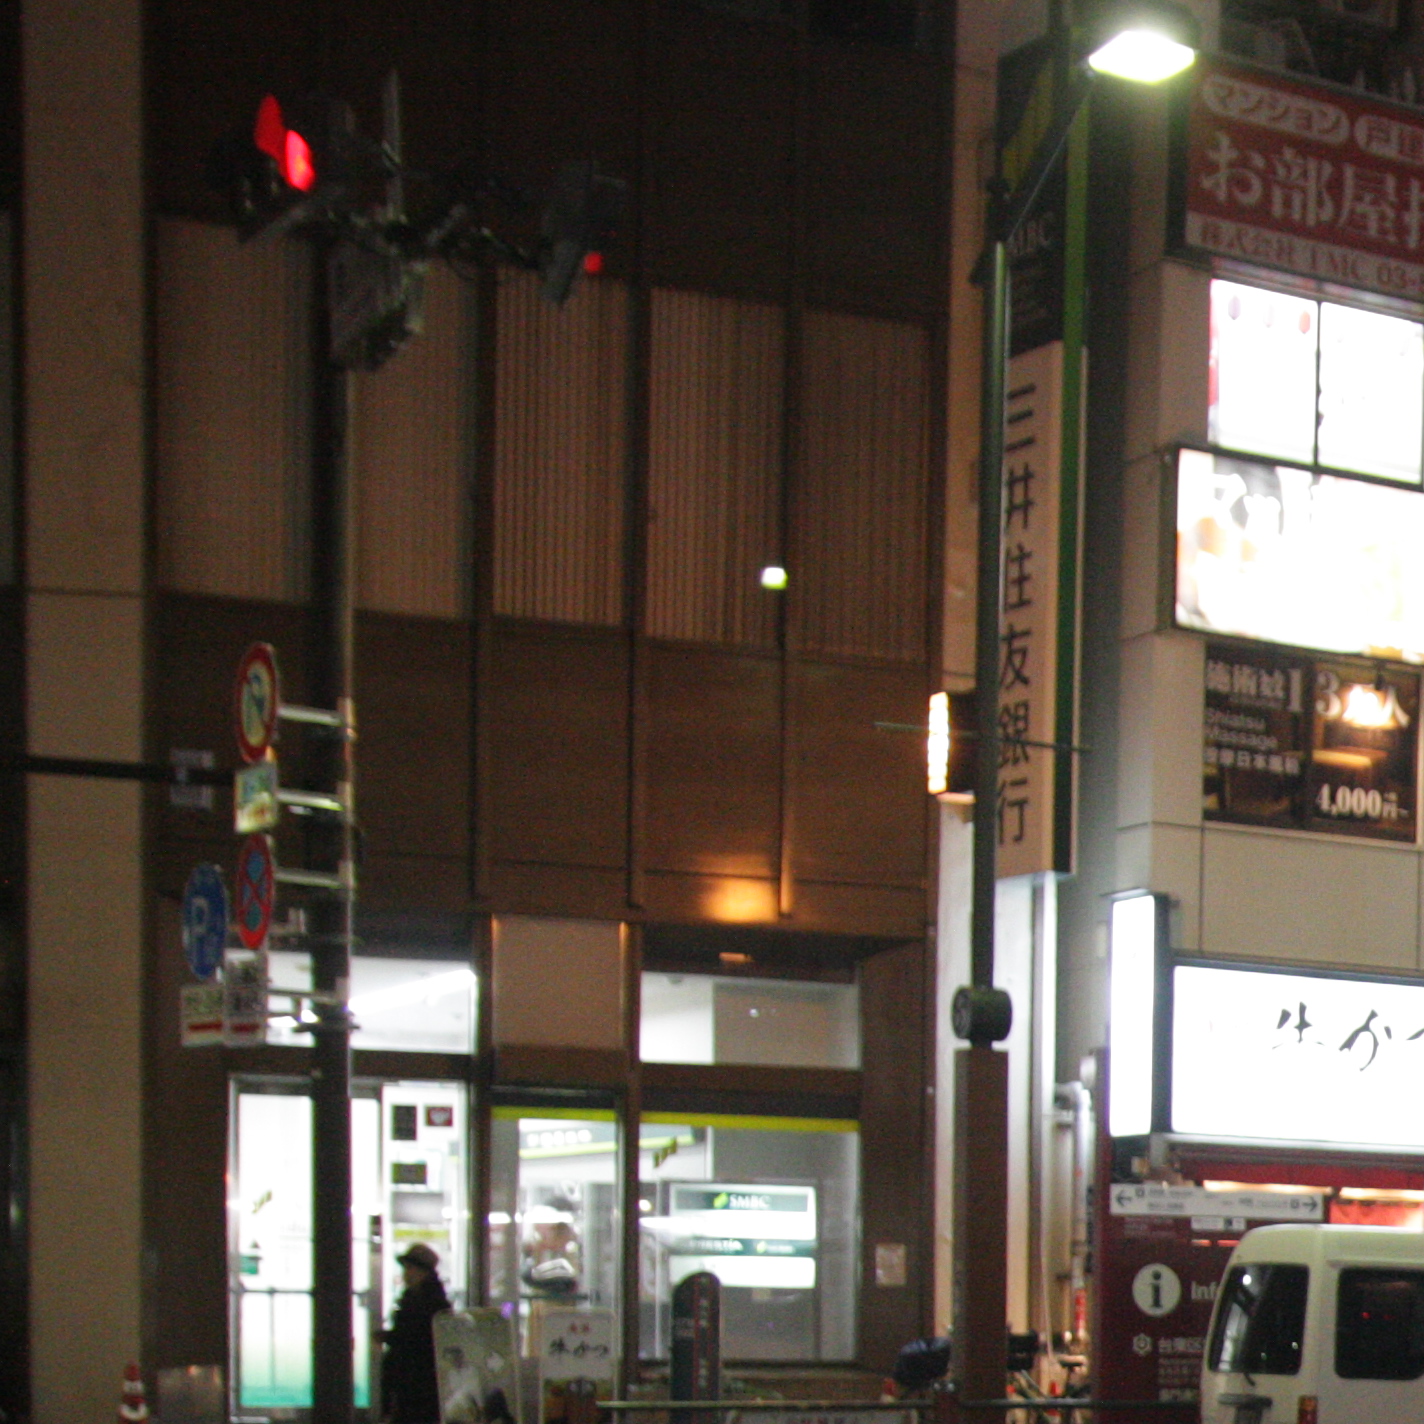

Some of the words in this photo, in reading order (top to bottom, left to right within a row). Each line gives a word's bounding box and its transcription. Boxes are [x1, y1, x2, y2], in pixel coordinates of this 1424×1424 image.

[998, 382, 1037, 846] 三井住友銀行
